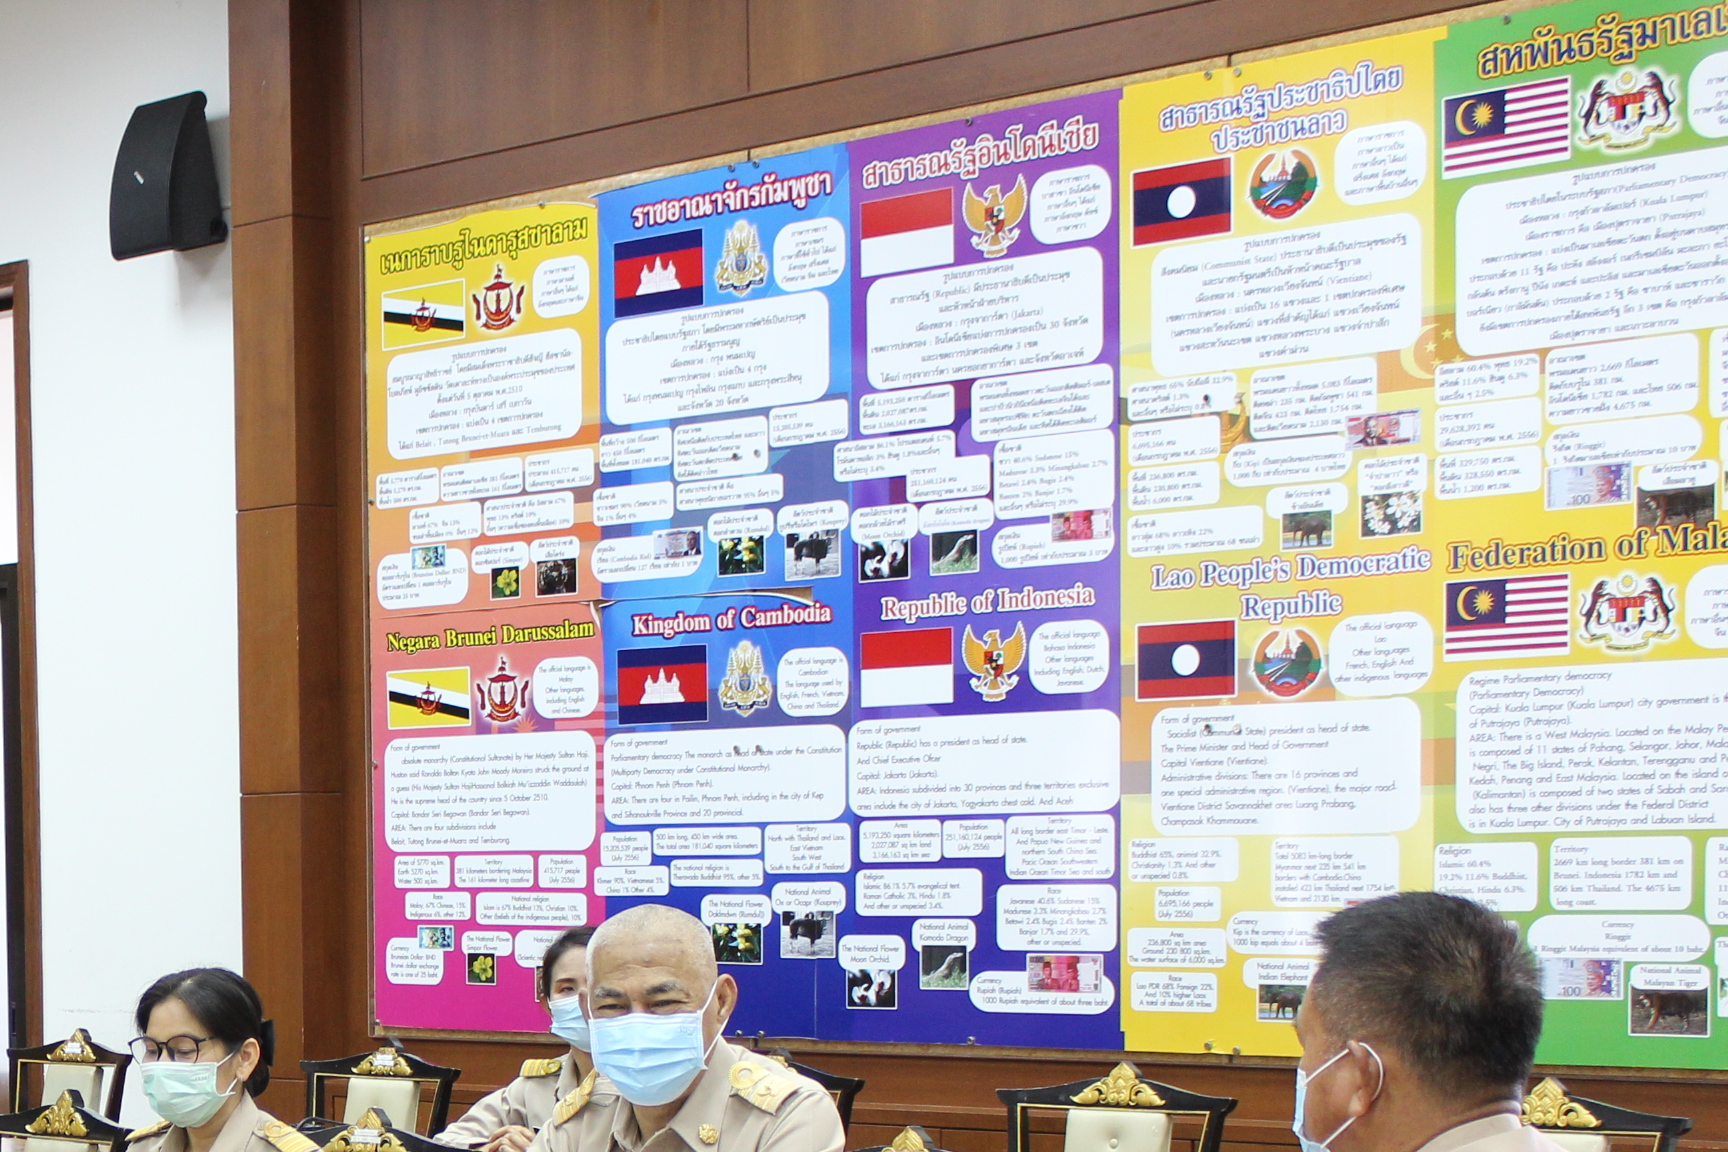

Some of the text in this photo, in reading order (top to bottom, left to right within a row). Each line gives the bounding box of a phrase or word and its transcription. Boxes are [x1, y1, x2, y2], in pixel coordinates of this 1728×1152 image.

[1479, 3, 1728, 79] สหพันธรัฐมาเลเ
[1160, 60, 1403, 132] สาธารณรัฐประชาธิปไตย
[863, 115, 1101, 188] สาธารณรัฐอินโดนีเซีย
[1211, 110, 1348, 152] ประชาชนลาว
[632, 172, 833, 228] ราชอาณาจักรกัมพูชา
[1151, 564, 1196, 590] Lao
[1296, 547, 1432, 581] Democratic
[1446, 532, 1606, 573] Federation
[1615, 525, 1650, 559] of
[632, 601, 833, 638] Kingdom of Cambodia
[881, 582, 1096, 624] Republic of Indonesia
[1241, 590, 1342, 623] Republic
[386, 619, 596, 655] Negara Brunei Darussalam
